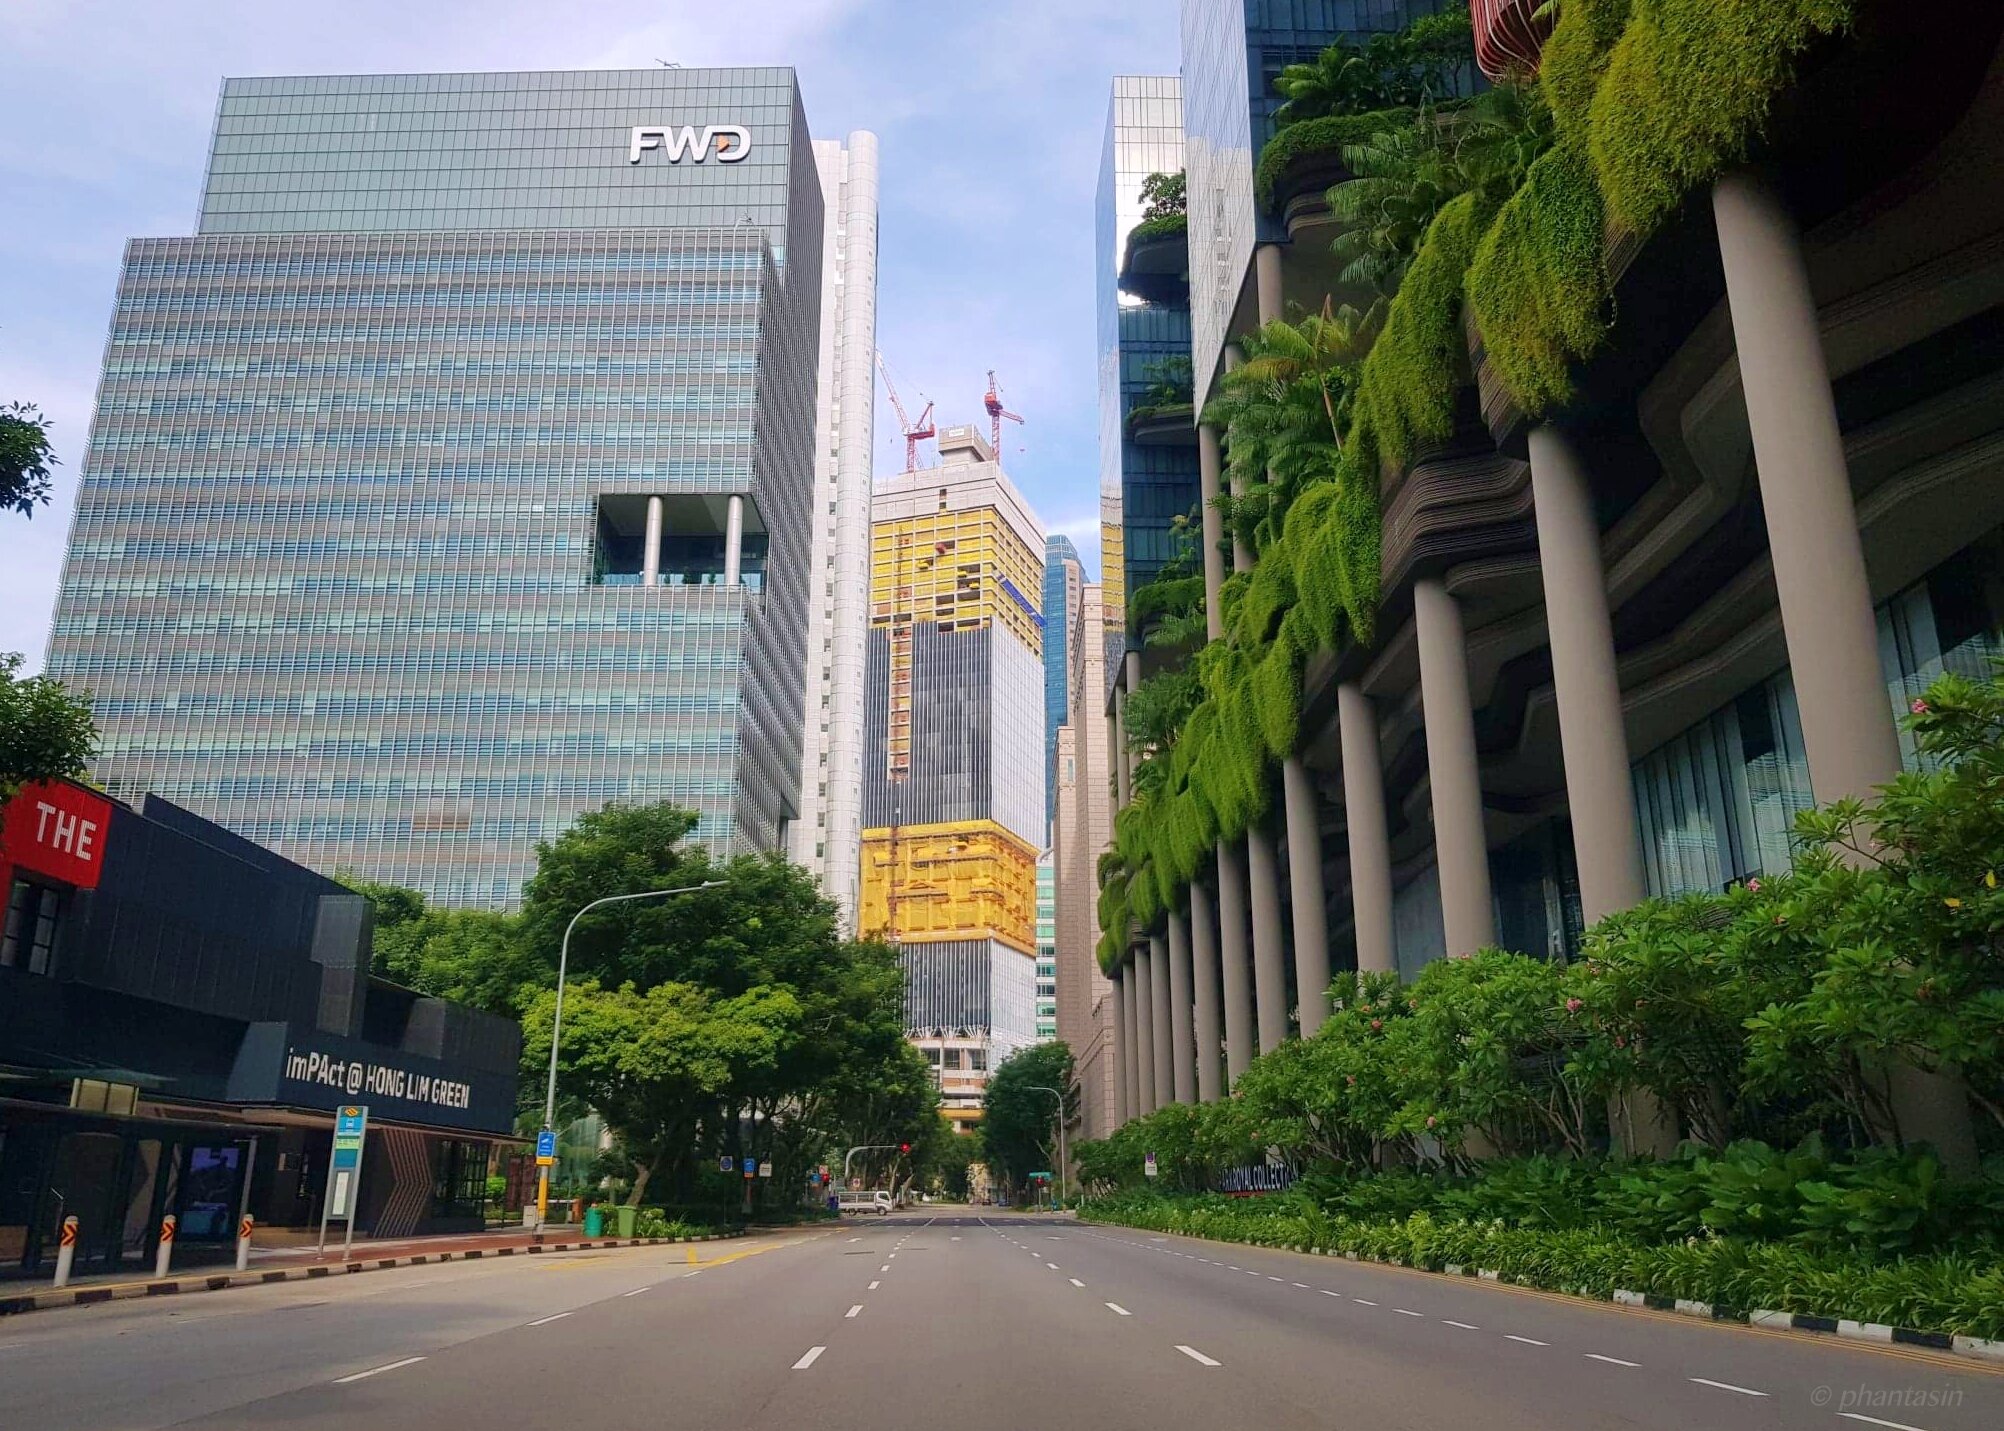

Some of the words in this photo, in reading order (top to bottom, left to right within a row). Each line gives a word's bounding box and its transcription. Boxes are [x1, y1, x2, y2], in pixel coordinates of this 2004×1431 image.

[630, 125, 751, 163] FWD
[37, 801, 97, 861] THE
[285, 1047, 345, 1088] imPAct
[347, 1062, 363, 1095] @
[365, 1064, 404, 1098] HONG
[406, 1073, 430, 1102] LIM
[431, 1078, 471, 1109] GREEN
